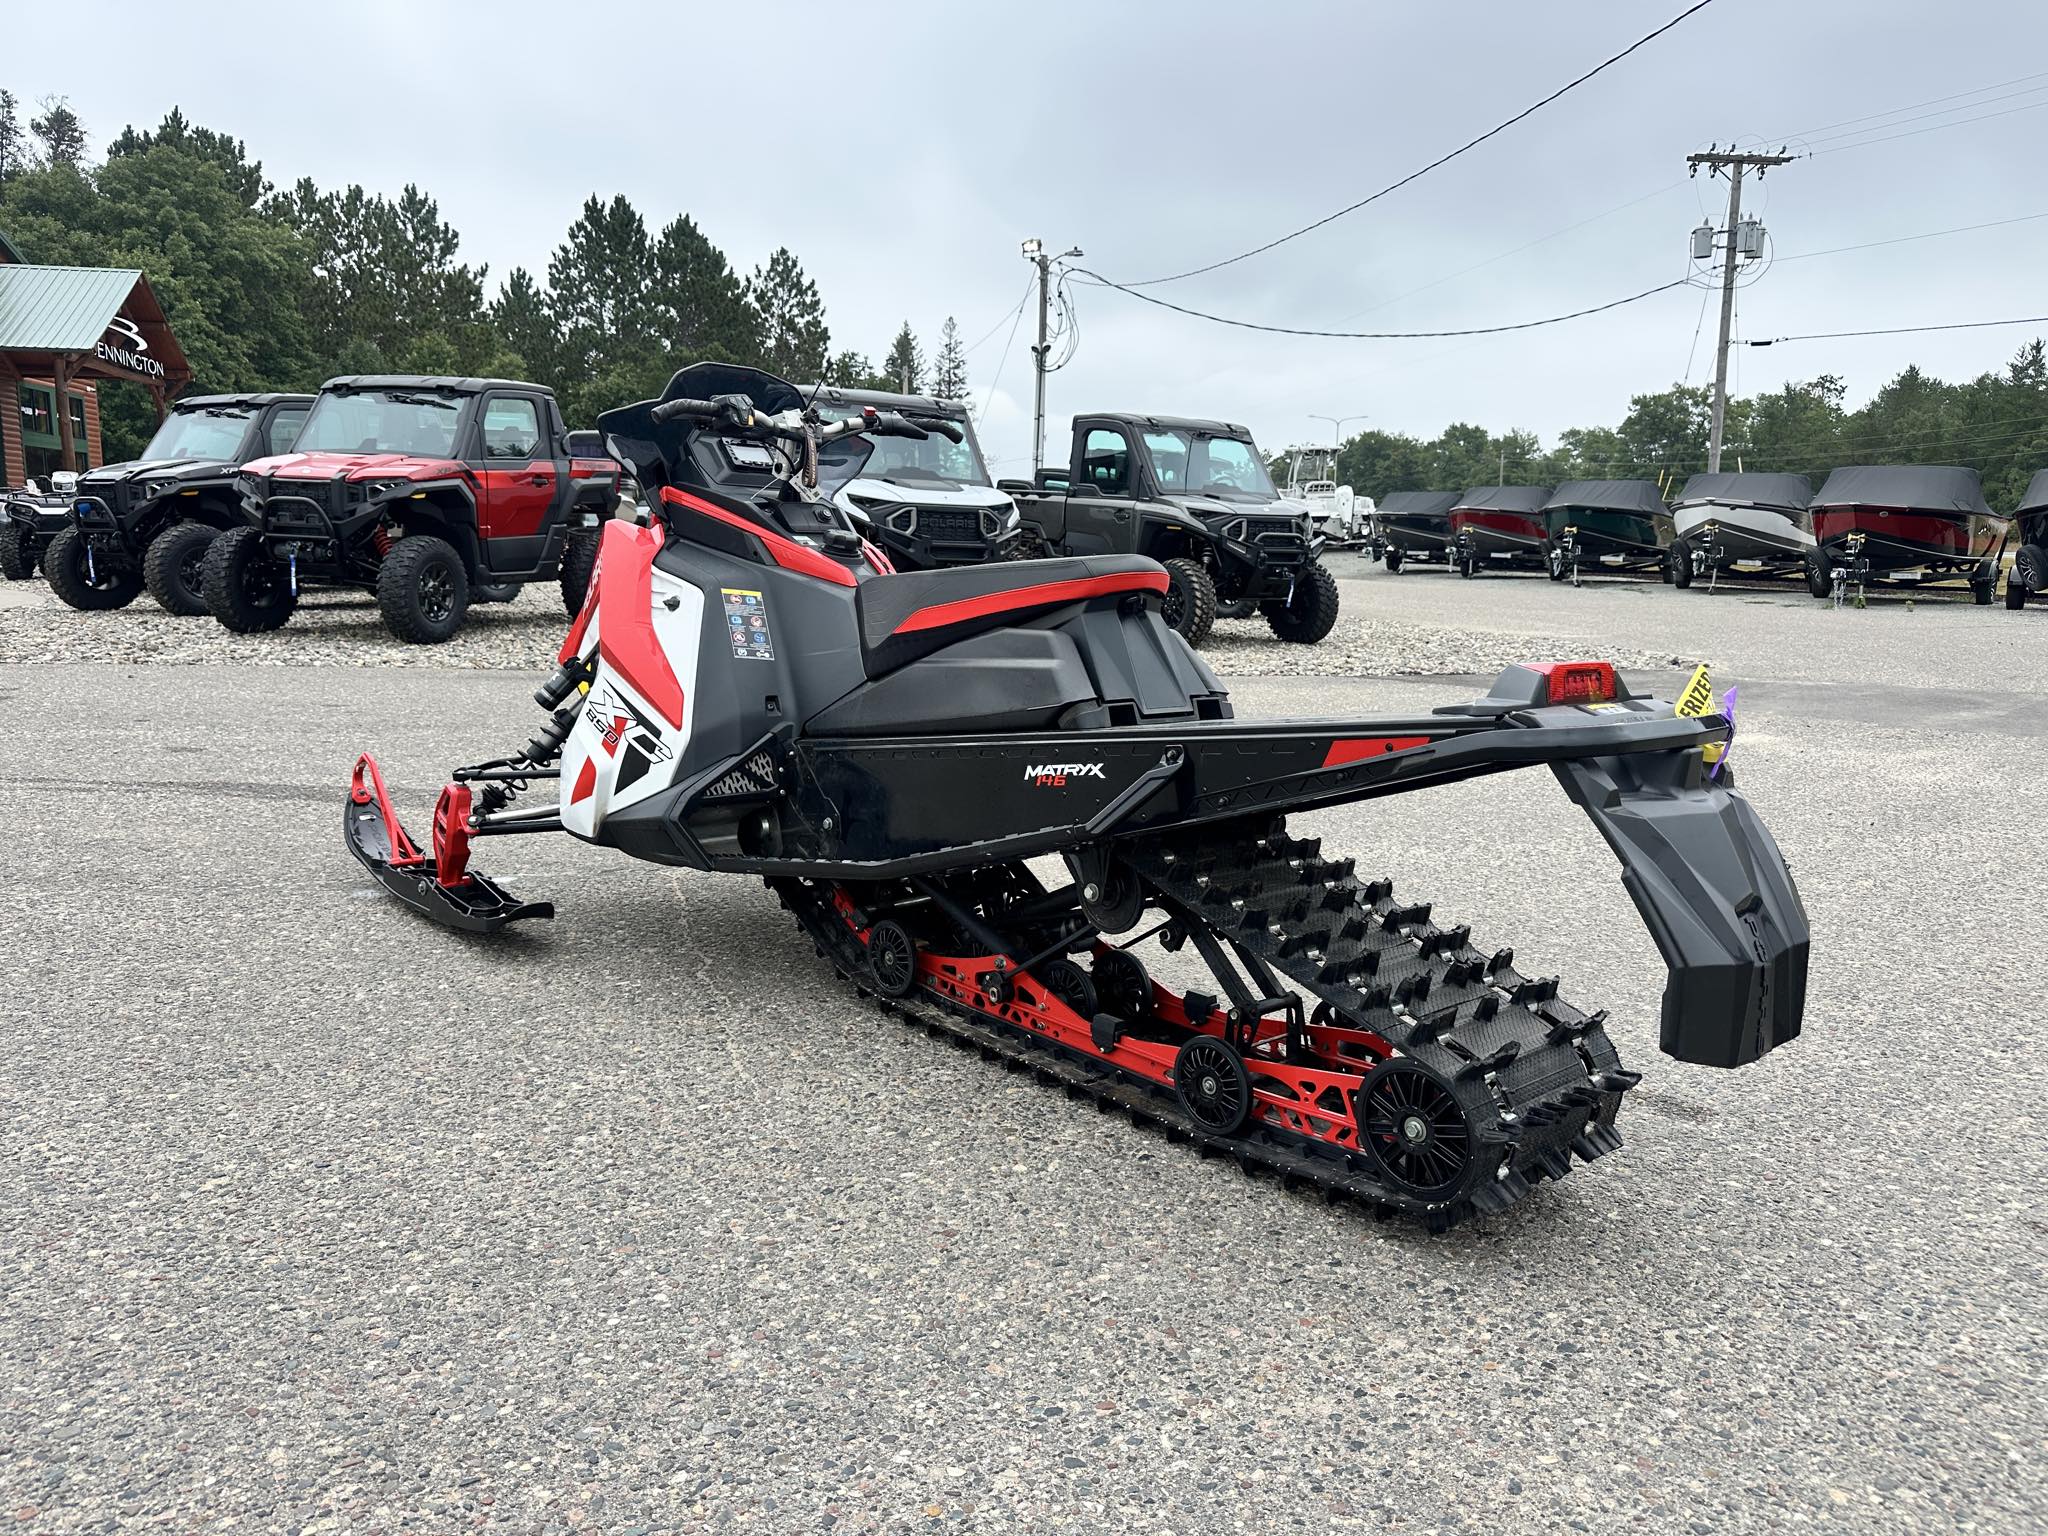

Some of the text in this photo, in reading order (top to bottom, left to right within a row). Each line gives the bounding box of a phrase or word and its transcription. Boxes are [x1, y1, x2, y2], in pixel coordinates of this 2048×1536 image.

[94, 341, 165, 377] ENNINGTON
[920, 517, 977, 529] POLARIS
[585, 708, 620, 745] 850
[588, 688, 674, 764] XC
[1023, 762, 1107, 781] MATRYX
[1035, 775, 1067, 787] 146
